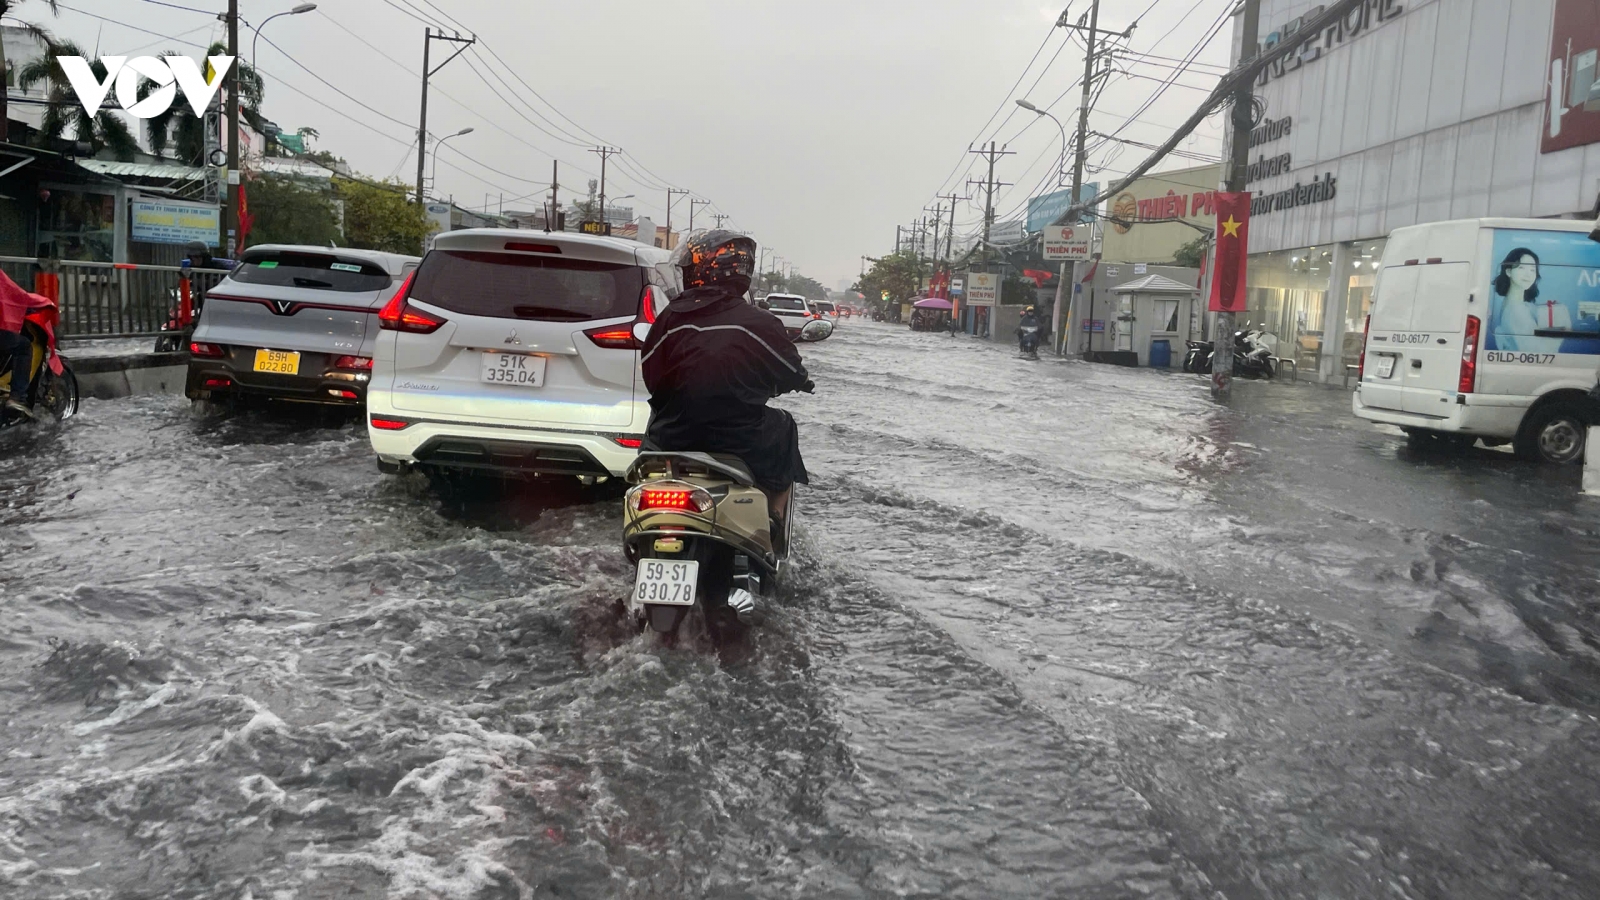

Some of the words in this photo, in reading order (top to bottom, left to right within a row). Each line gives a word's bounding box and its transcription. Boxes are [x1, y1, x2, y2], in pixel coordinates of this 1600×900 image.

[1274, 171, 1337, 211] materials
[1137, 189, 1188, 221] THIÊN
[1190, 189, 1218, 217] PH
[1046, 245, 1069, 254] THIÊN
[969, 290, 984, 298] THIÊN
[1391, 333, 1430, 344] 61LD-061.77
[268, 352, 288, 362] 69H
[499, 355, 527, 369] 51K
[1487, 352, 1555, 365] 61LD-061.77
[259, 362, 293, 373] 022.80
[486, 368, 536, 384] 335.04
[646, 562, 687, 581] 59-S1
[638, 583, 692, 602] 830.78
